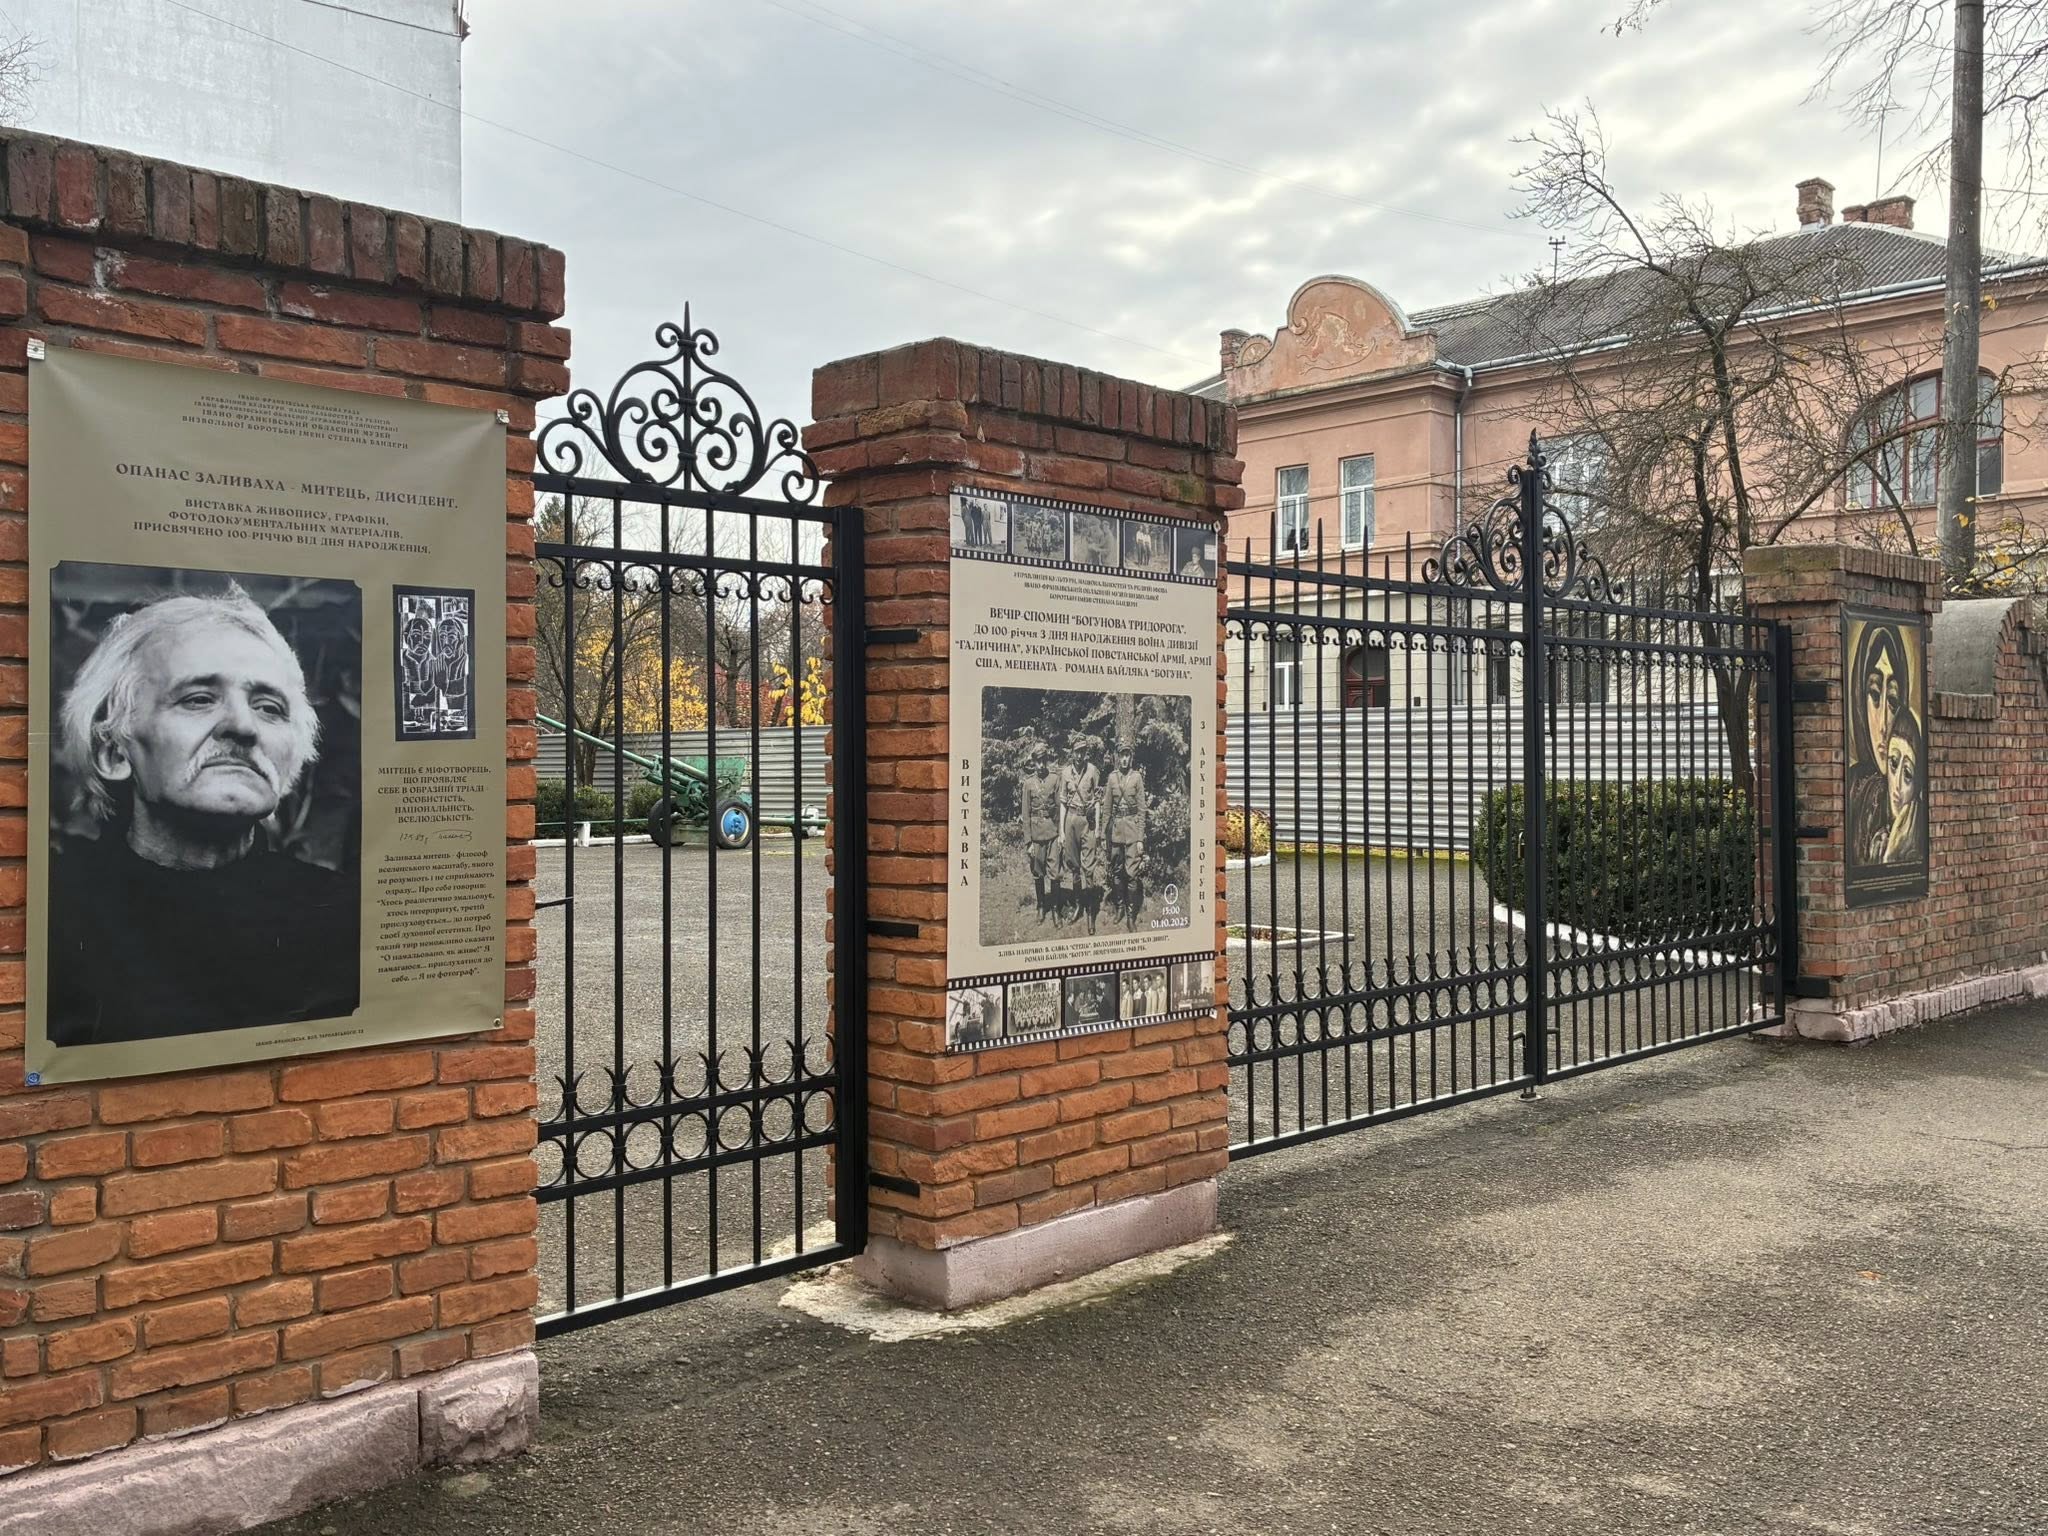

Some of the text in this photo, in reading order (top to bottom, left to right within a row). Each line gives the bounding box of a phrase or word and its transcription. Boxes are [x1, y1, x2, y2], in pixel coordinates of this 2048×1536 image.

[182, 415, 408, 449] ВИЗВОЛЬНОЇ БОРОТЬБИ ІМЕНІ СТЕПАНА БАНДЕРИ
[311, 424, 360, 435] ОБЛАСНИЙ
[363, 430, 391, 440] МУЗЕЙ
[116, 463, 190, 481] ОПАНАС
[195, 472, 286, 492] ЗАЛИВАХА
[301, 483, 370, 501] МИТЕЦЬ,
[375, 490, 458, 509] ДИСИДЕНТ.
[185, 499, 252, 513] ВИСТАВКА
[168, 511, 326, 533] ФОТОДОКУМЕНТАЛЬНИХ
[134, 521, 223, 537] ПРИСВЯЧЕНО
[297, 536, 317, 545] ВІД
[320, 537, 344, 547] ДНЯ
[990, 607, 1069, 624] ВЕЧІР-СПОМИН
[973, 624, 989, 635] ДО
[991, 626, 1007, 636] 100
[1010, 628, 1038, 639] річчя
[1048, 630, 1068, 641] ДНЯ
[1071, 631, 1136, 646] НАРОДЖЕННЯ
[1138, 636, 1165, 648] ВОЇНА
[1167, 639, 1198, 650] ДИВІЗІЇ
[1026, 644, 1089, 658] УКРАЇНСЬКОЇ
[1091, 648, 1159, 663] ПОВСТАНСЬКОЇ
[1188, 655, 1212, 666] АРМІЇ
[1004, 659, 1057, 672] МЕЦЕНАТА
[1065, 663, 1104, 675] РОМАНА
[1107, 665, 1149, 677] БАЙЛЯКА
[378, 767, 416, 775] МИТЕЦЬ
[420, 776, 467, 784] ПРОЯВЛЯЄ
[410, 786, 454, 794] ОБРАЗНІЙ
[960, 759, 970, 887] ВИСТАВКА
[456, 850, 488, 859] філософ
[418, 886, 434, 894] Про
[1151, 917, 1189, 928] 01.10.2025
